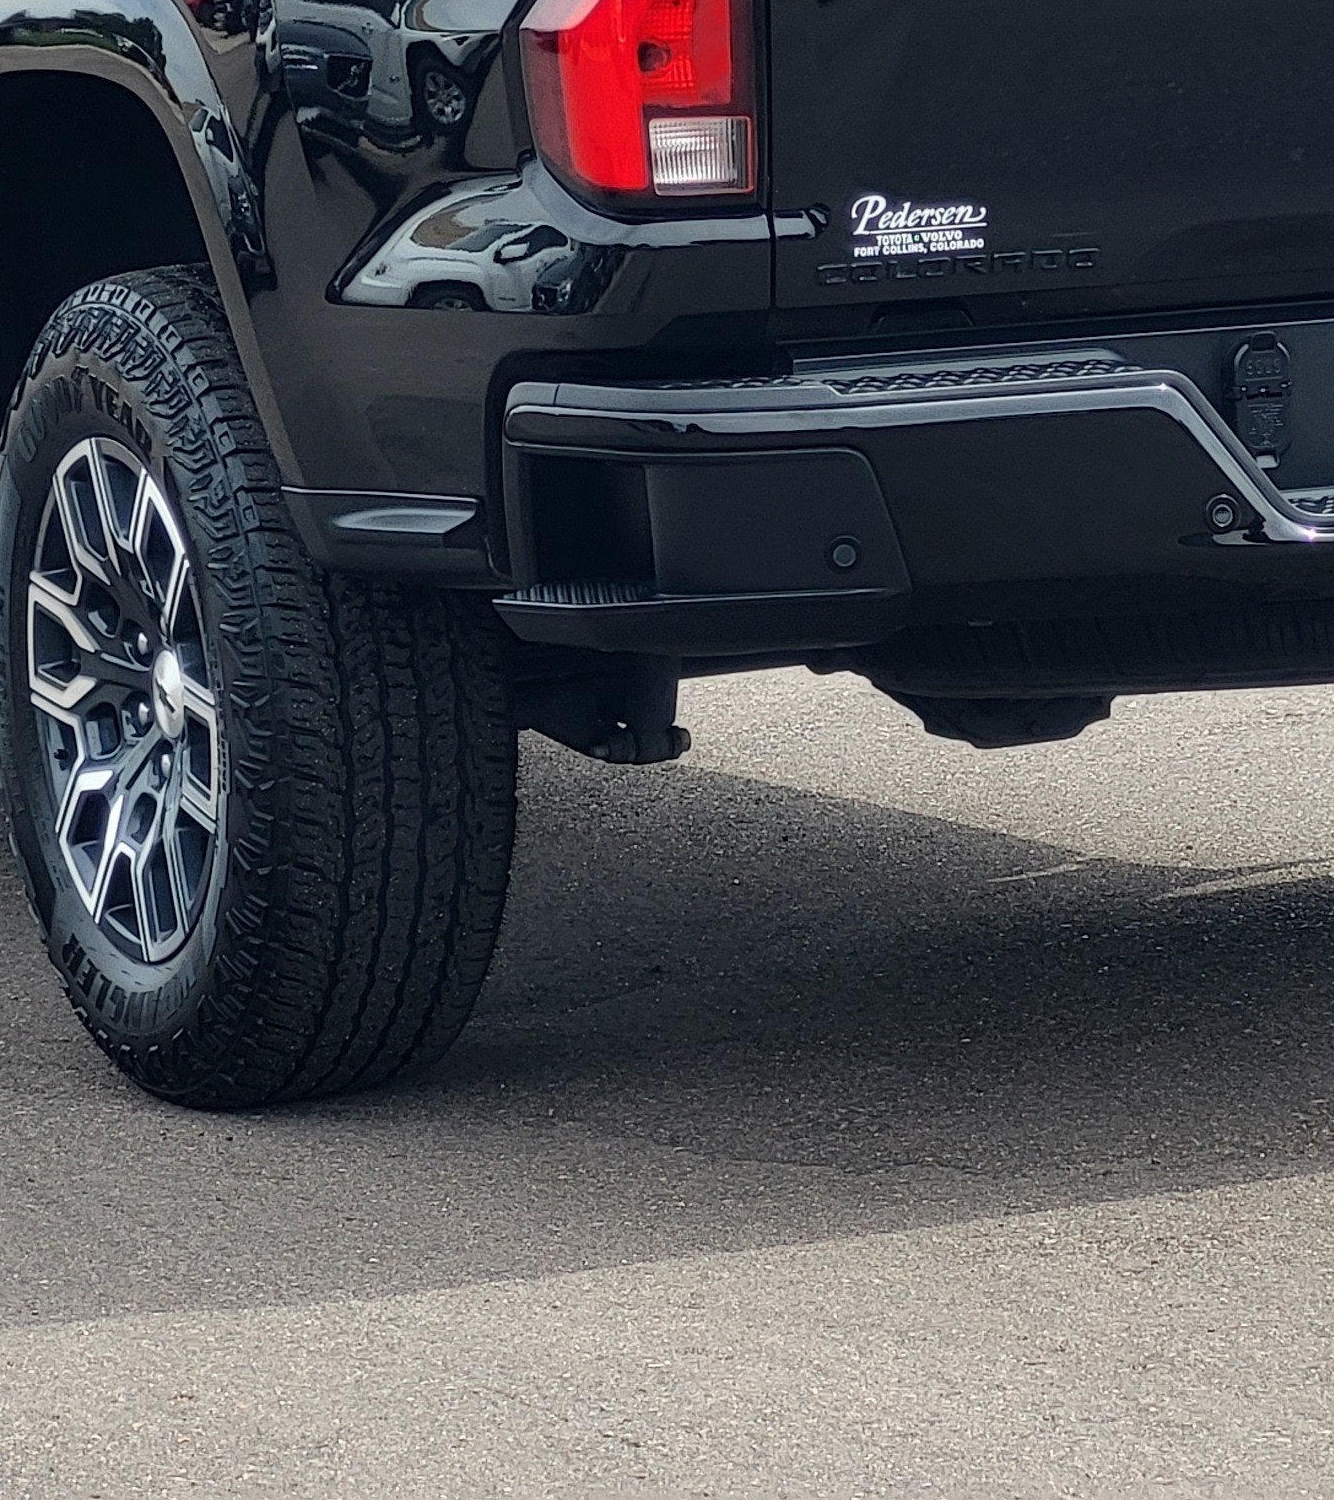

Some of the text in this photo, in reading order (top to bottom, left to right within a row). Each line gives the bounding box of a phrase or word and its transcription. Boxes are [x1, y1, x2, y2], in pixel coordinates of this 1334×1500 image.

[851, 195, 987, 235] Pedersen
[854, 238, 985, 257] FORT COLLINS, COLORADO
[876, 230, 963, 246] TOYOTA VOLVO
[817, 248, 1100, 285] COLORADO
